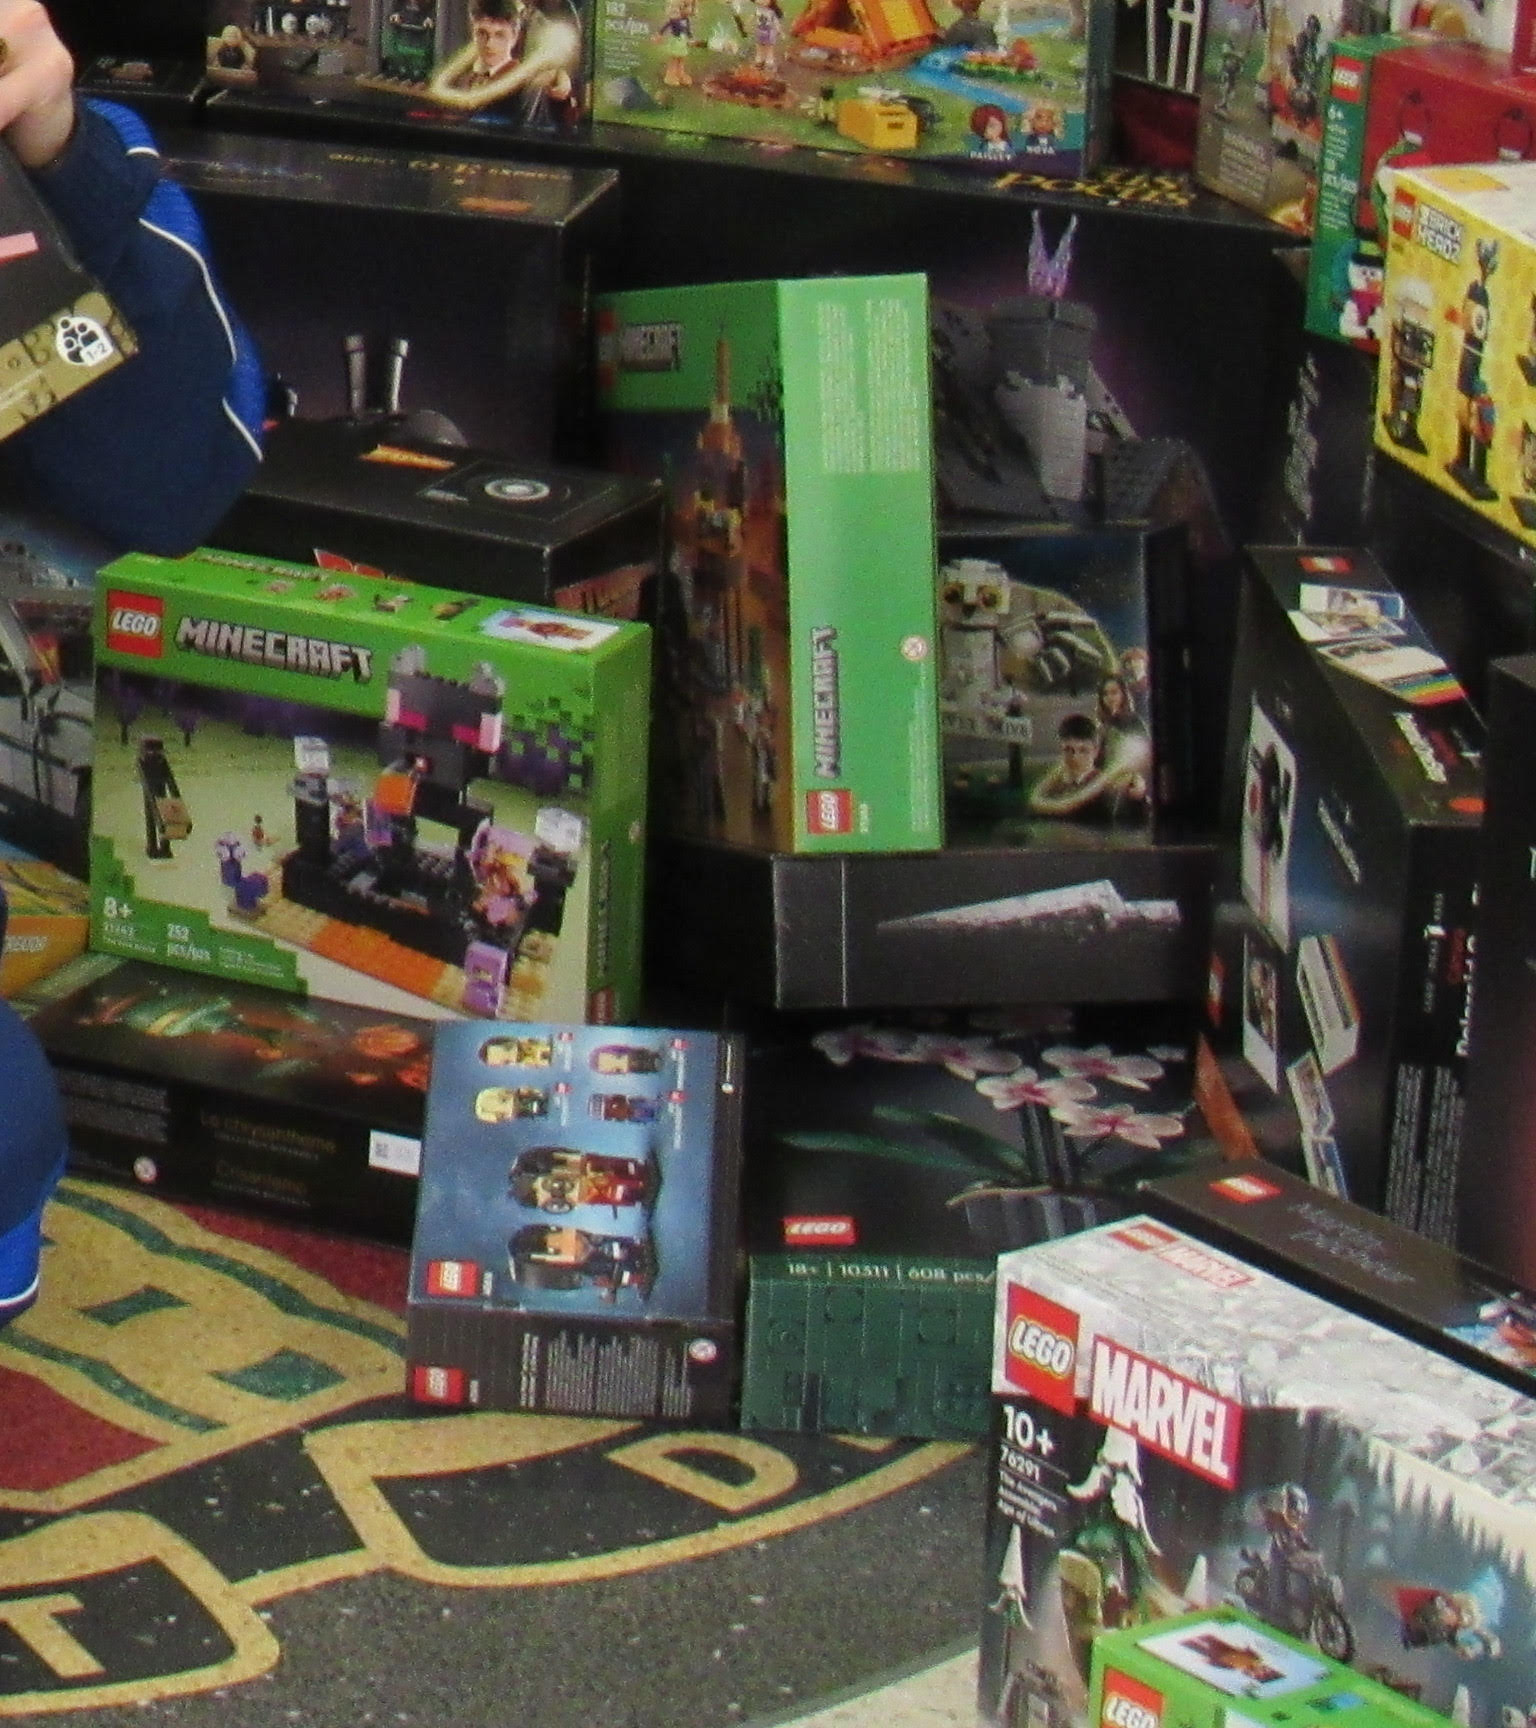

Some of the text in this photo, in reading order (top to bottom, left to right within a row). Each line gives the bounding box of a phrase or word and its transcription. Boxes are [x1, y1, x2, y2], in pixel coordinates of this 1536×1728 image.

[109, 610, 158, 639] LEGO
[174, 615, 375, 683] MINECRAFT
[809, 625, 838, 780] MINECRAFT
[788, 1221, 848, 1235] LEGO
[839, 1263, 945, 1281] 10311 608
[1009, 1318, 1074, 1376] LEGO
[1003, 1405, 1053, 1455] 10+
[1093, 1344, 1237, 1485] MARVEL
[1000, 1446, 1041, 1481] 76291
